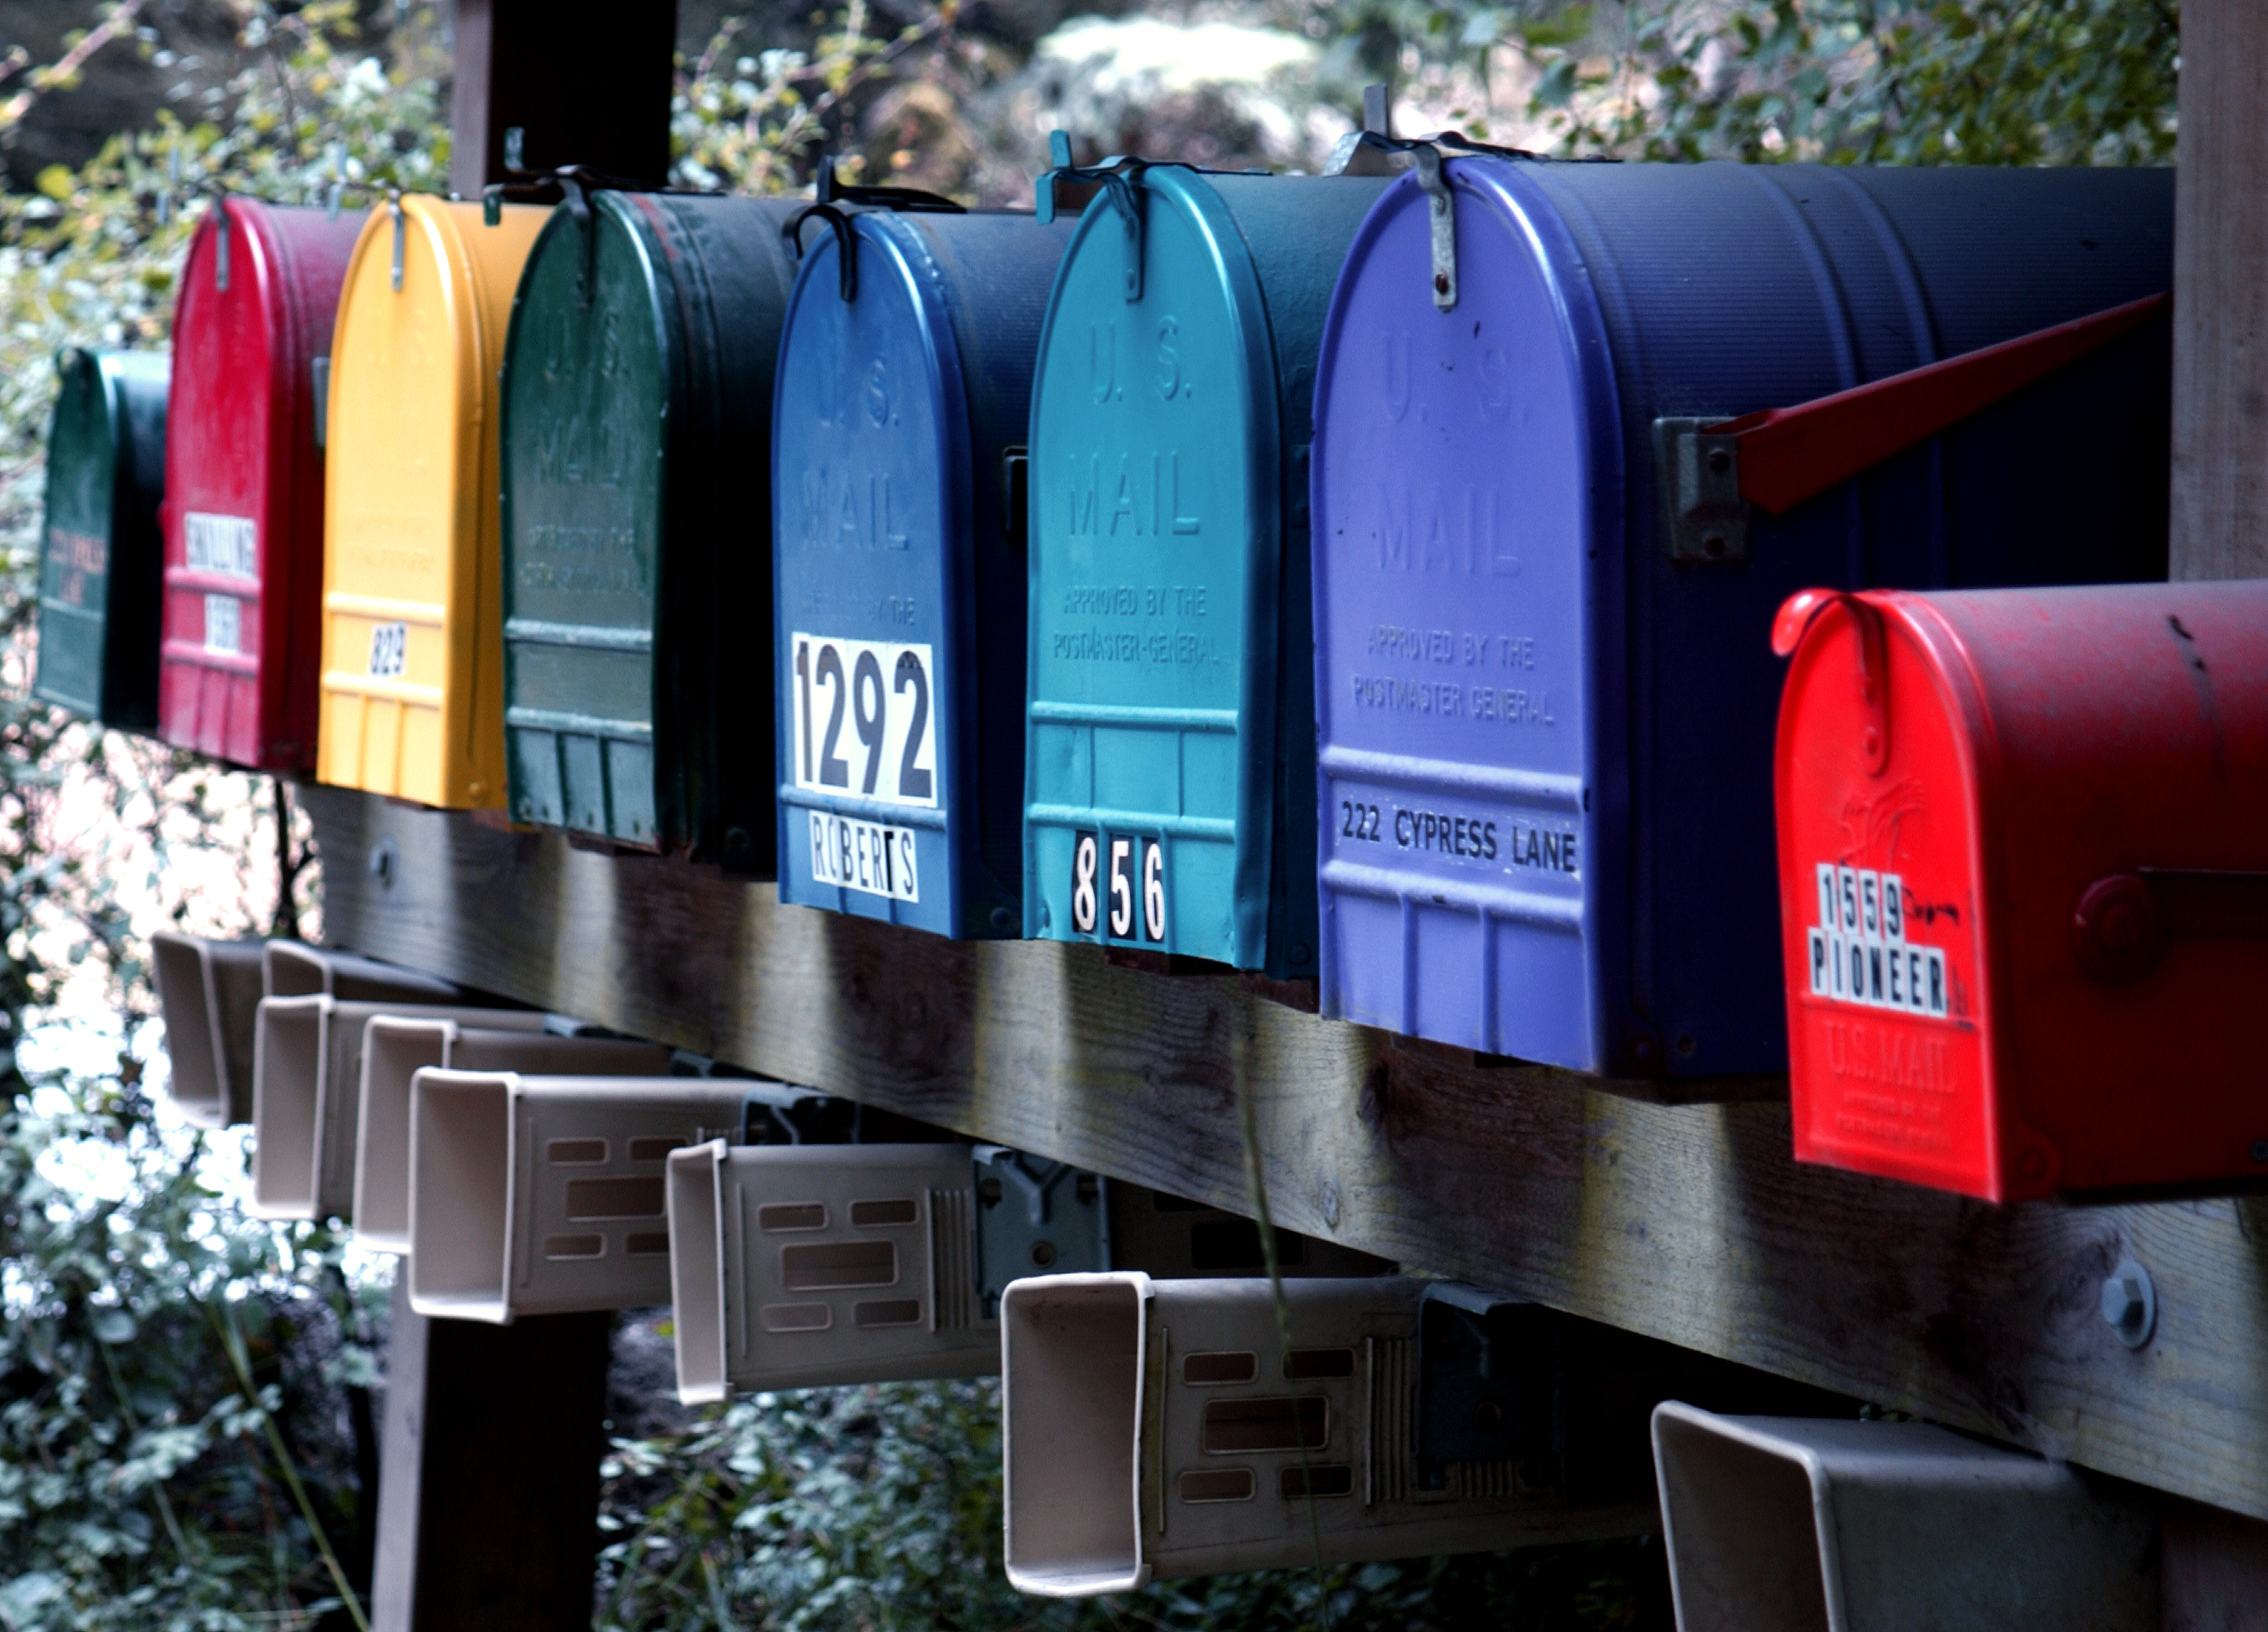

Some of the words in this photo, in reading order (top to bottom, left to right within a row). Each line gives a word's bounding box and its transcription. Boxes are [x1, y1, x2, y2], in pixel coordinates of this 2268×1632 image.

[1091, 316, 1124, 406] U.
[1155, 314, 1192, 402] S.
[1382, 331, 1429, 425] U.
[802, 471, 914, 551] MAIL
[1068, 449, 1201, 537] MAIL
[1376, 482, 1522, 579] MAIL
[1063, 584, 1138, 617] APPROVED
[1146, 585, 1166, 617] BY
[1174, 585, 1206, 618] THE
[1366, 624, 1456, 665] APPROVED
[1463, 632, 1489, 667] BY
[1499, 635, 1536, 673] THE
[796, 640, 933, 800] 1292
[1353, 673, 1462, 719] POSTMASTER
[1470, 685, 1556, 729] GENERAL
[1342, 800, 1381, 843] 222
[1395, 808, 1498, 861] CYPRESS
[1512, 825, 1577, 873] LANE
[1073, 836, 1166, 941] 856
[1823, 872, 1902, 938] 1559
[1813, 935, 1944, 1012] PIONEER
[1878, 1029, 1958, 1093] MAIL
